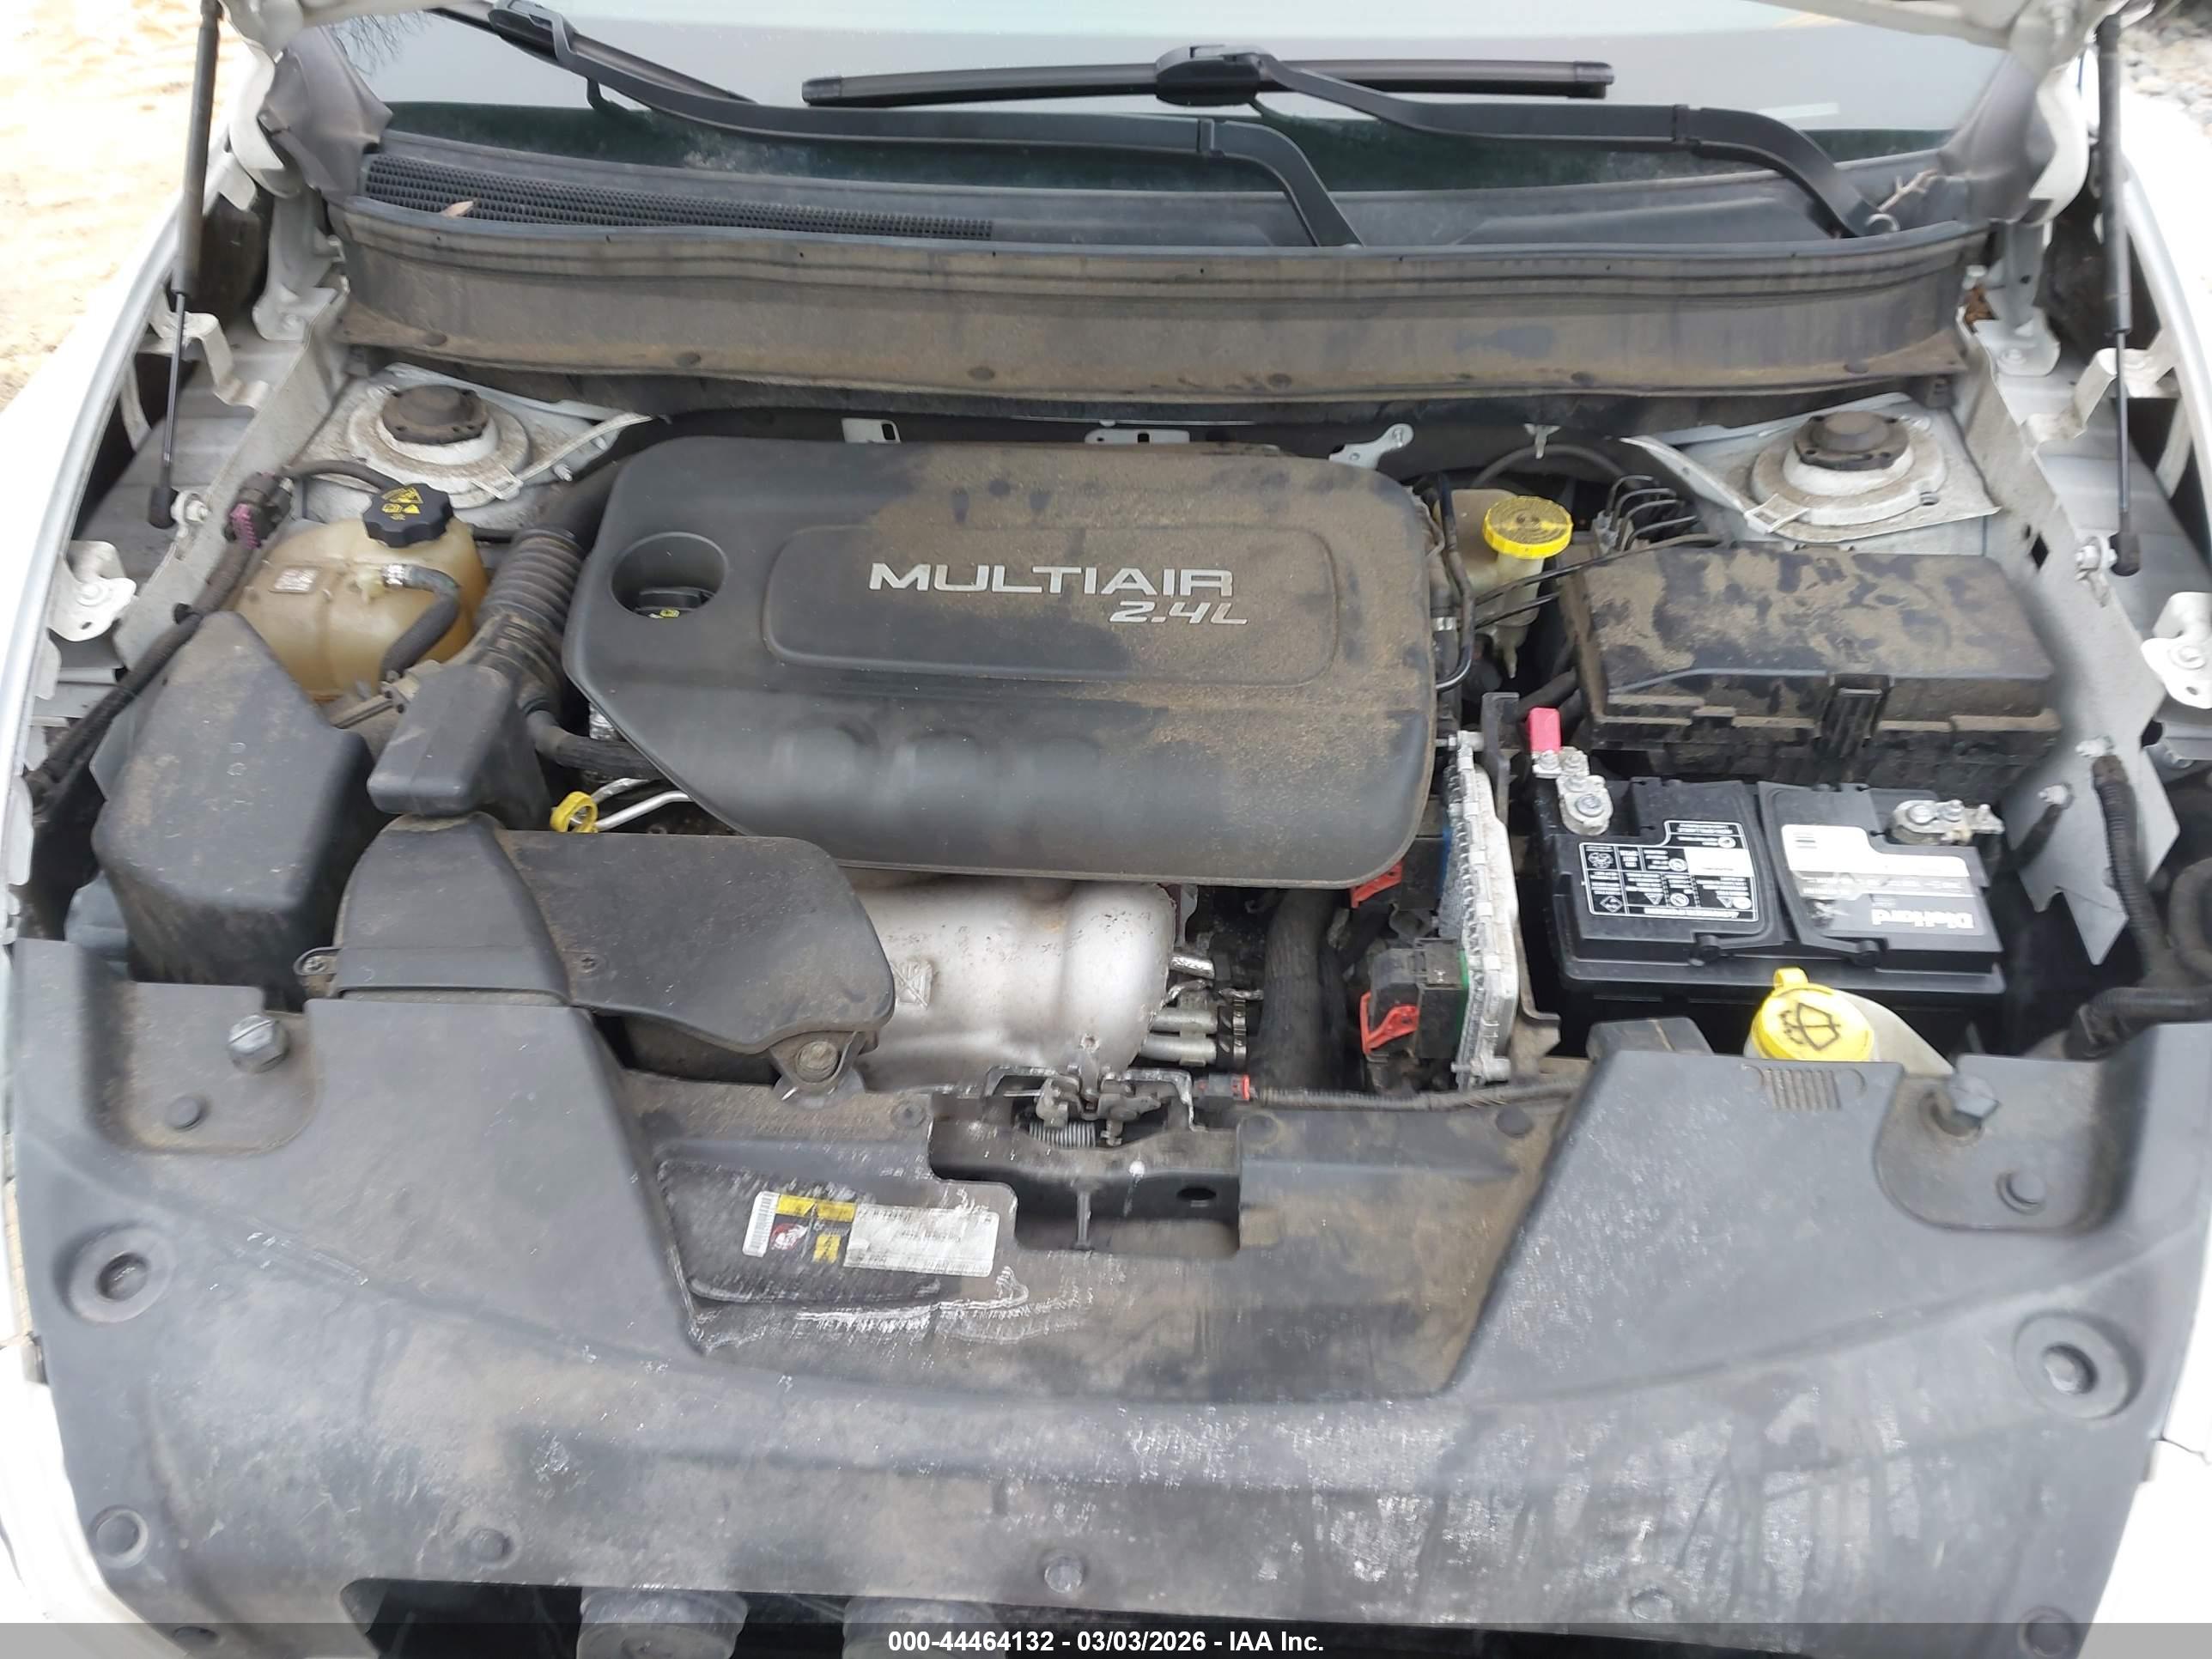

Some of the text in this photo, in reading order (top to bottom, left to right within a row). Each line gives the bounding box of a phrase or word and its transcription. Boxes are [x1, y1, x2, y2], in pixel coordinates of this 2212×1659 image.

[867, 562, 1234, 598] MULTIAIR
[1107, 599, 1249, 625] 2.4L
[1871, 908, 1974, 929] DieHard
